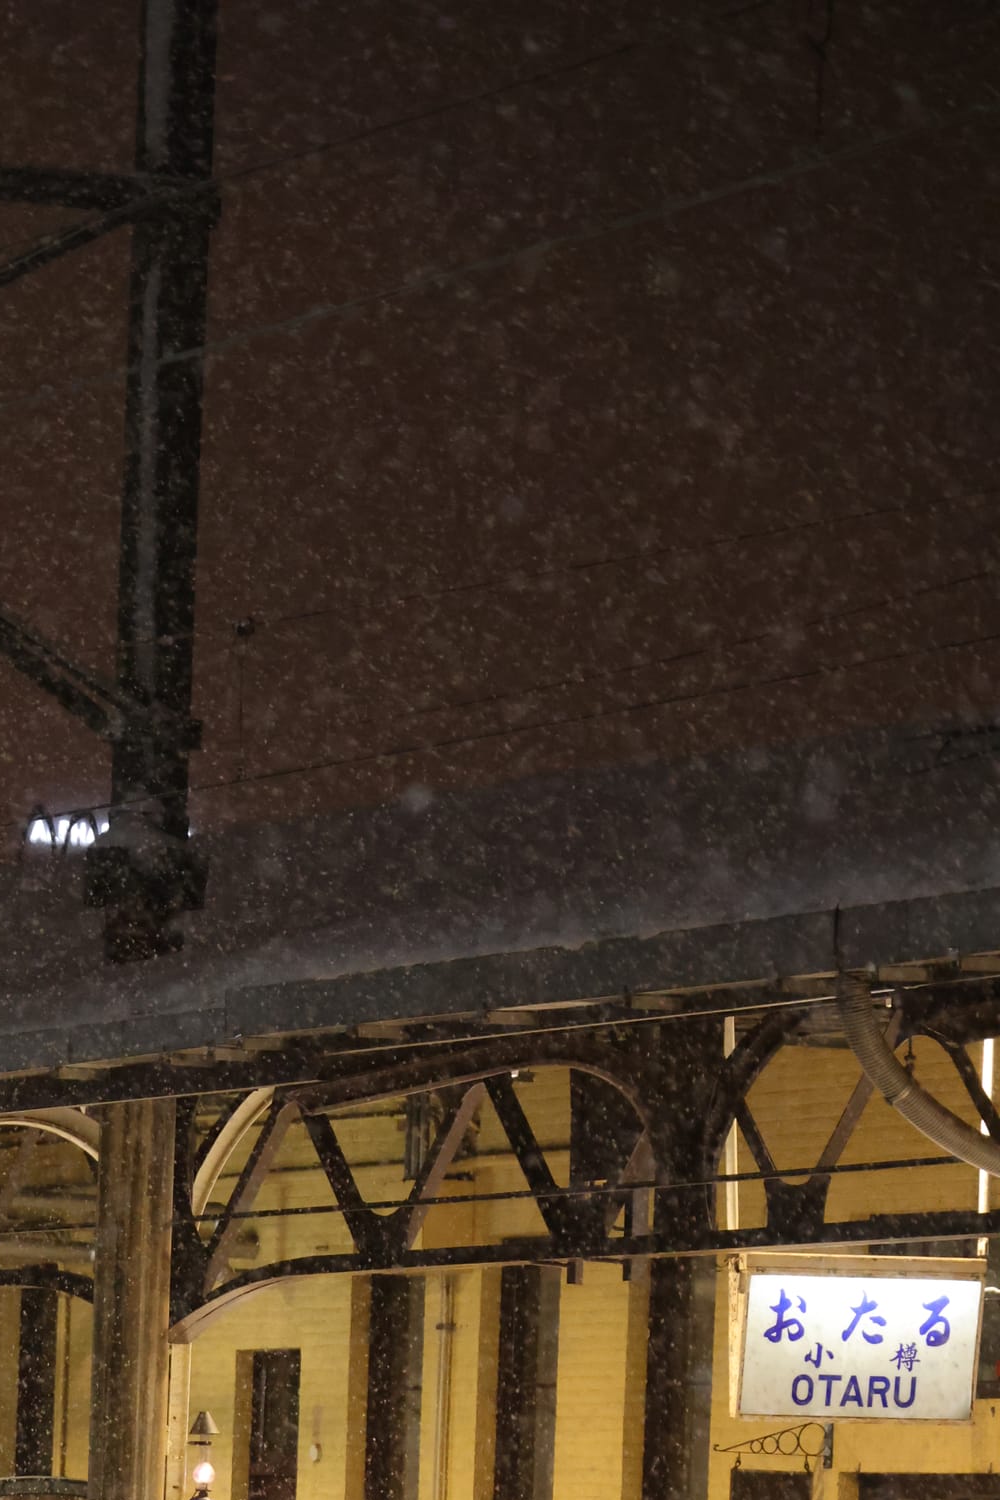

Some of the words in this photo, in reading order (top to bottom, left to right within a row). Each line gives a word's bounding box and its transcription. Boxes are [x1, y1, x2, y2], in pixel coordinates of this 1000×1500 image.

[763, 1288, 951, 1347] おたる
[804, 1342, 921, 1372] 小樽
[791, 1374, 917, 1408] OTARU
